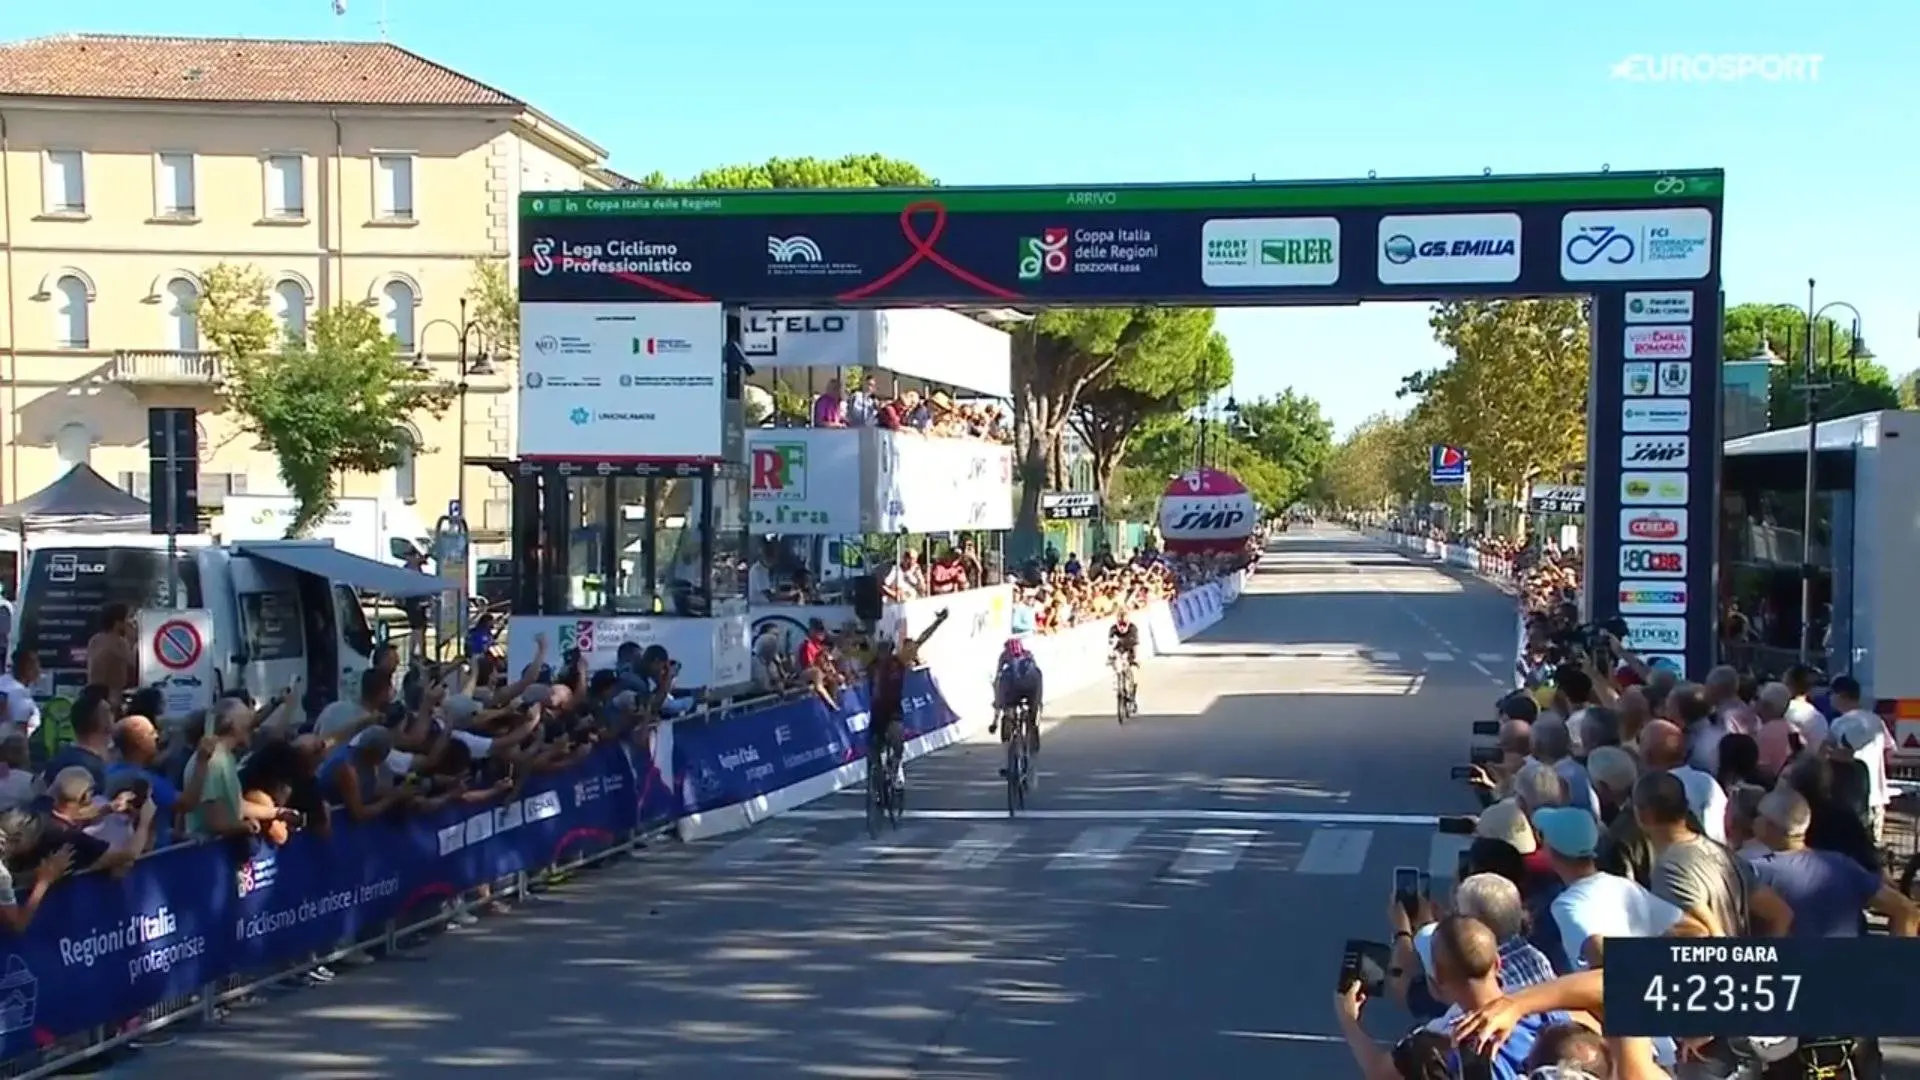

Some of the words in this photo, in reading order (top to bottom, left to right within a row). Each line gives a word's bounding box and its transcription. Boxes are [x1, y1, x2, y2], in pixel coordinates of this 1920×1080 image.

[586, 198, 620, 211] Coppa
[622, 198, 650, 209] Italia
[652, 198, 679, 209] delle
[682, 197, 722, 210] Regioni
[1066, 191, 1117, 205] ARRIVO
[1074, 228, 1115, 244] Coppa
[1118, 227, 1151, 242] Italia
[1650, 227, 1669, 238] FCI
[562, 240, 602, 258] Lega
[606, 240, 679, 256] Ciclismo
[1208, 239, 1248, 249] SPORT
[1286, 238, 1335, 265] RER
[1418, 239, 1516, 258] GS.EMILIA
[1074, 244, 1108, 259] delle
[1110, 244, 1159, 261] Regioni
[1208, 249, 1248, 258] VALLEY
[562, 257, 693, 273] Professionistico
[1074, 262, 1119, 273] EDIZIONE
[1626, 448, 1686, 461] SMP
[1071, 506, 1091, 516] MT
[1539, 500, 1557, 512] 25
[1560, 500, 1581, 511] MT
[1172, 510, 1245, 530] SMP
[246, 906, 297, 939] ciclismo
[299, 897, 317, 922] che
[317, 888, 352, 915] unisce
[360, 872, 400, 903] territori
[59, 914, 126, 968] Regioni
[126, 906, 178, 947] d'Italia
[128, 934, 206, 985] protagoniste
